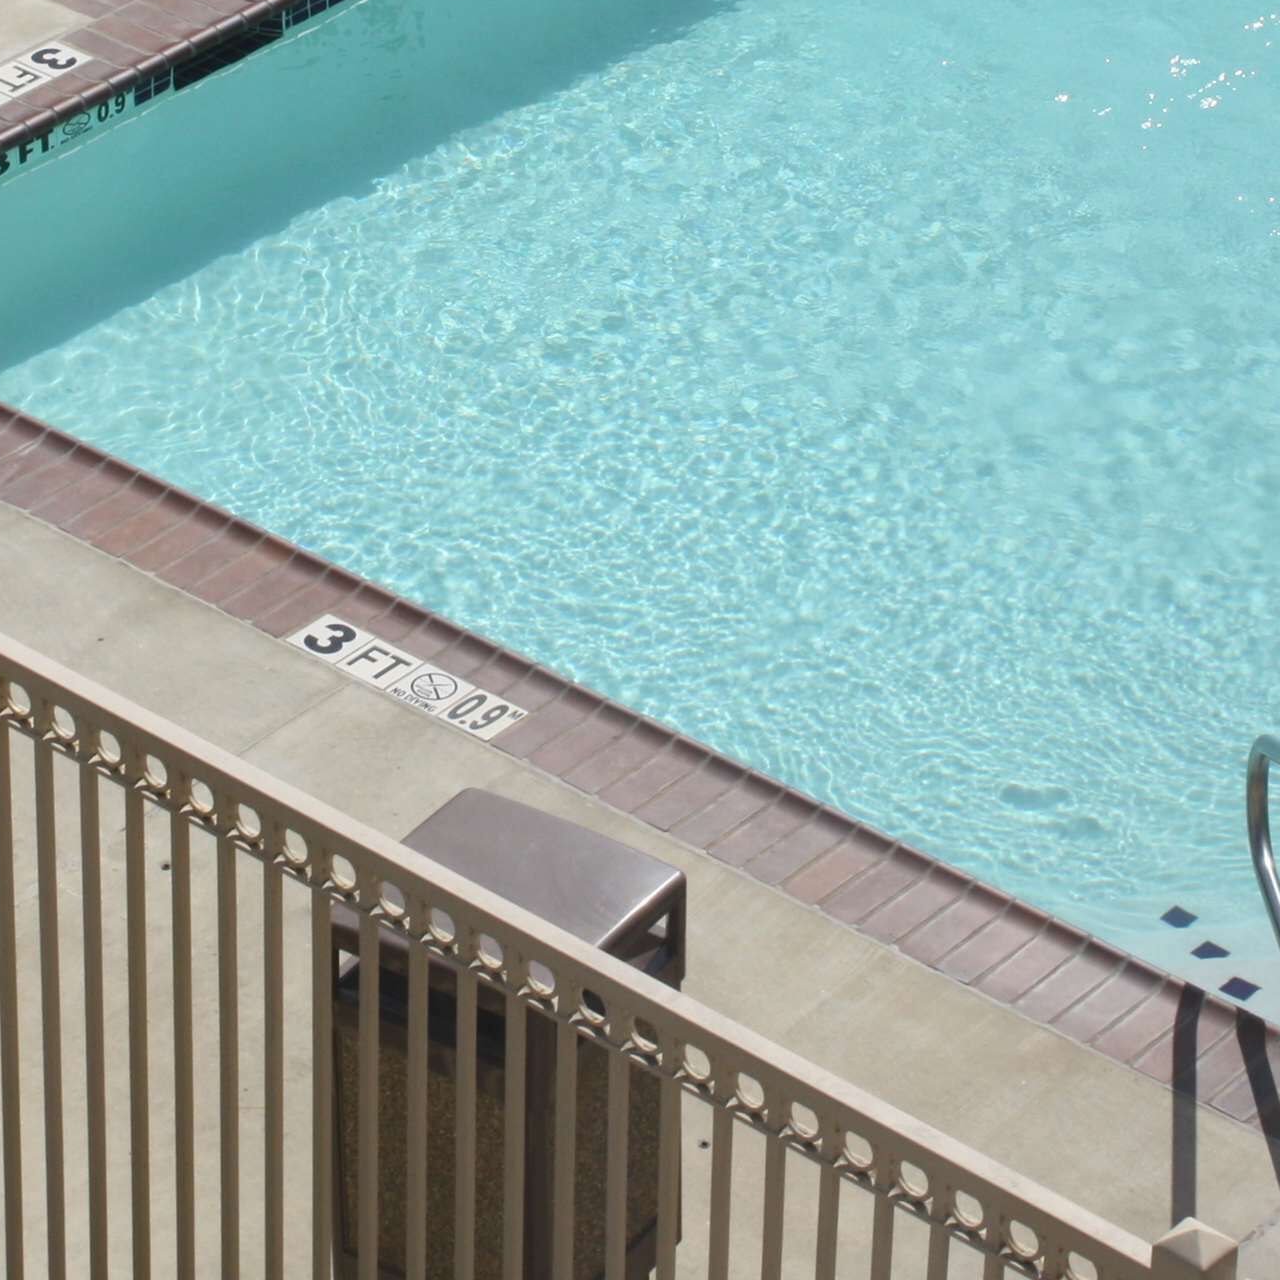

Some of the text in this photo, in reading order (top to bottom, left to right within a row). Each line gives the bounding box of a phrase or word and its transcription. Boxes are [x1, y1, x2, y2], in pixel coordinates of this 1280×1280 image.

[30, 48, 77, 70] 3
[303, 623, 357, 655] 3
[345, 645, 413, 680] FT
[391, 687, 437, 713] NO DIVING
